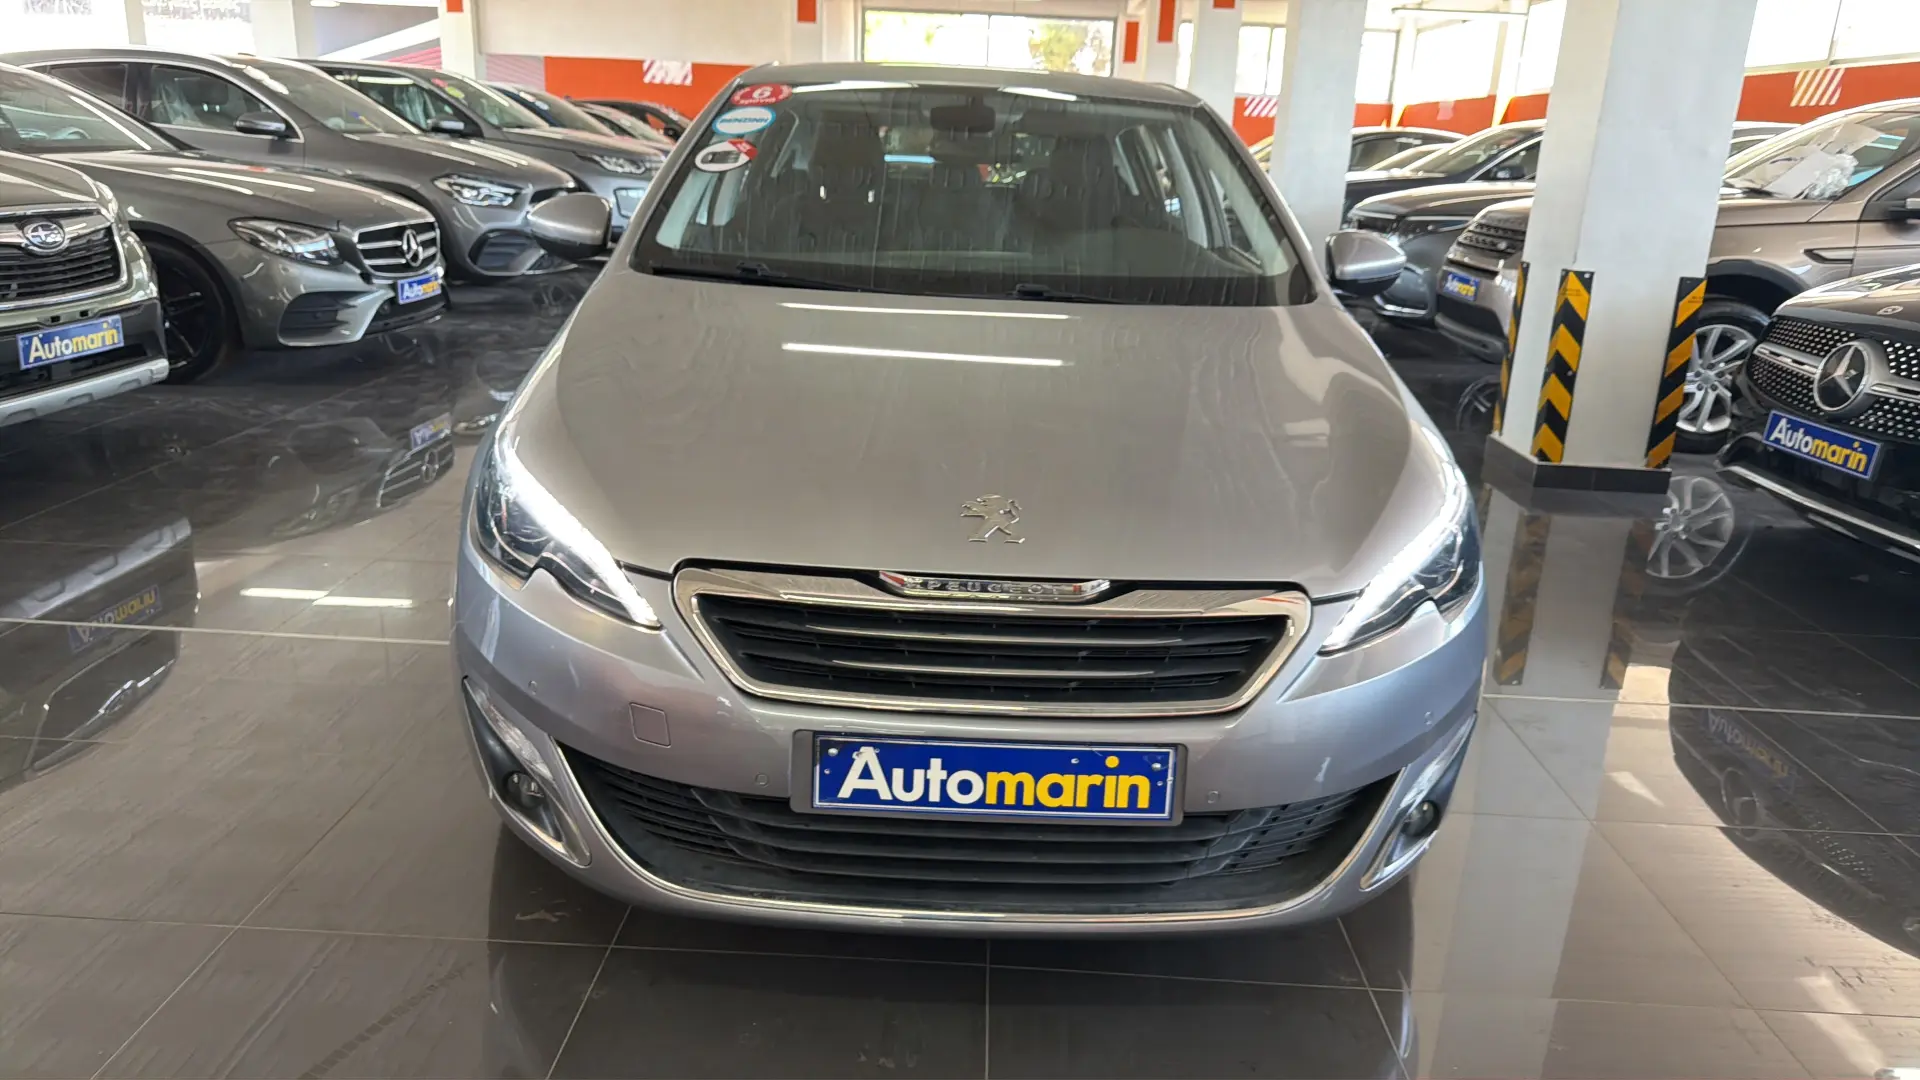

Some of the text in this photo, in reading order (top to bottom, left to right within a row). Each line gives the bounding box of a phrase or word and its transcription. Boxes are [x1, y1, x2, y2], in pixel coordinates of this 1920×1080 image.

[752, 86, 774, 99] 6
[28, 323, 118, 363] Automarin
[1769, 418, 1868, 472] Automarin
[926, 580, 1060, 595] PEUGEOT
[837, 746, 1151, 809] Automarin
